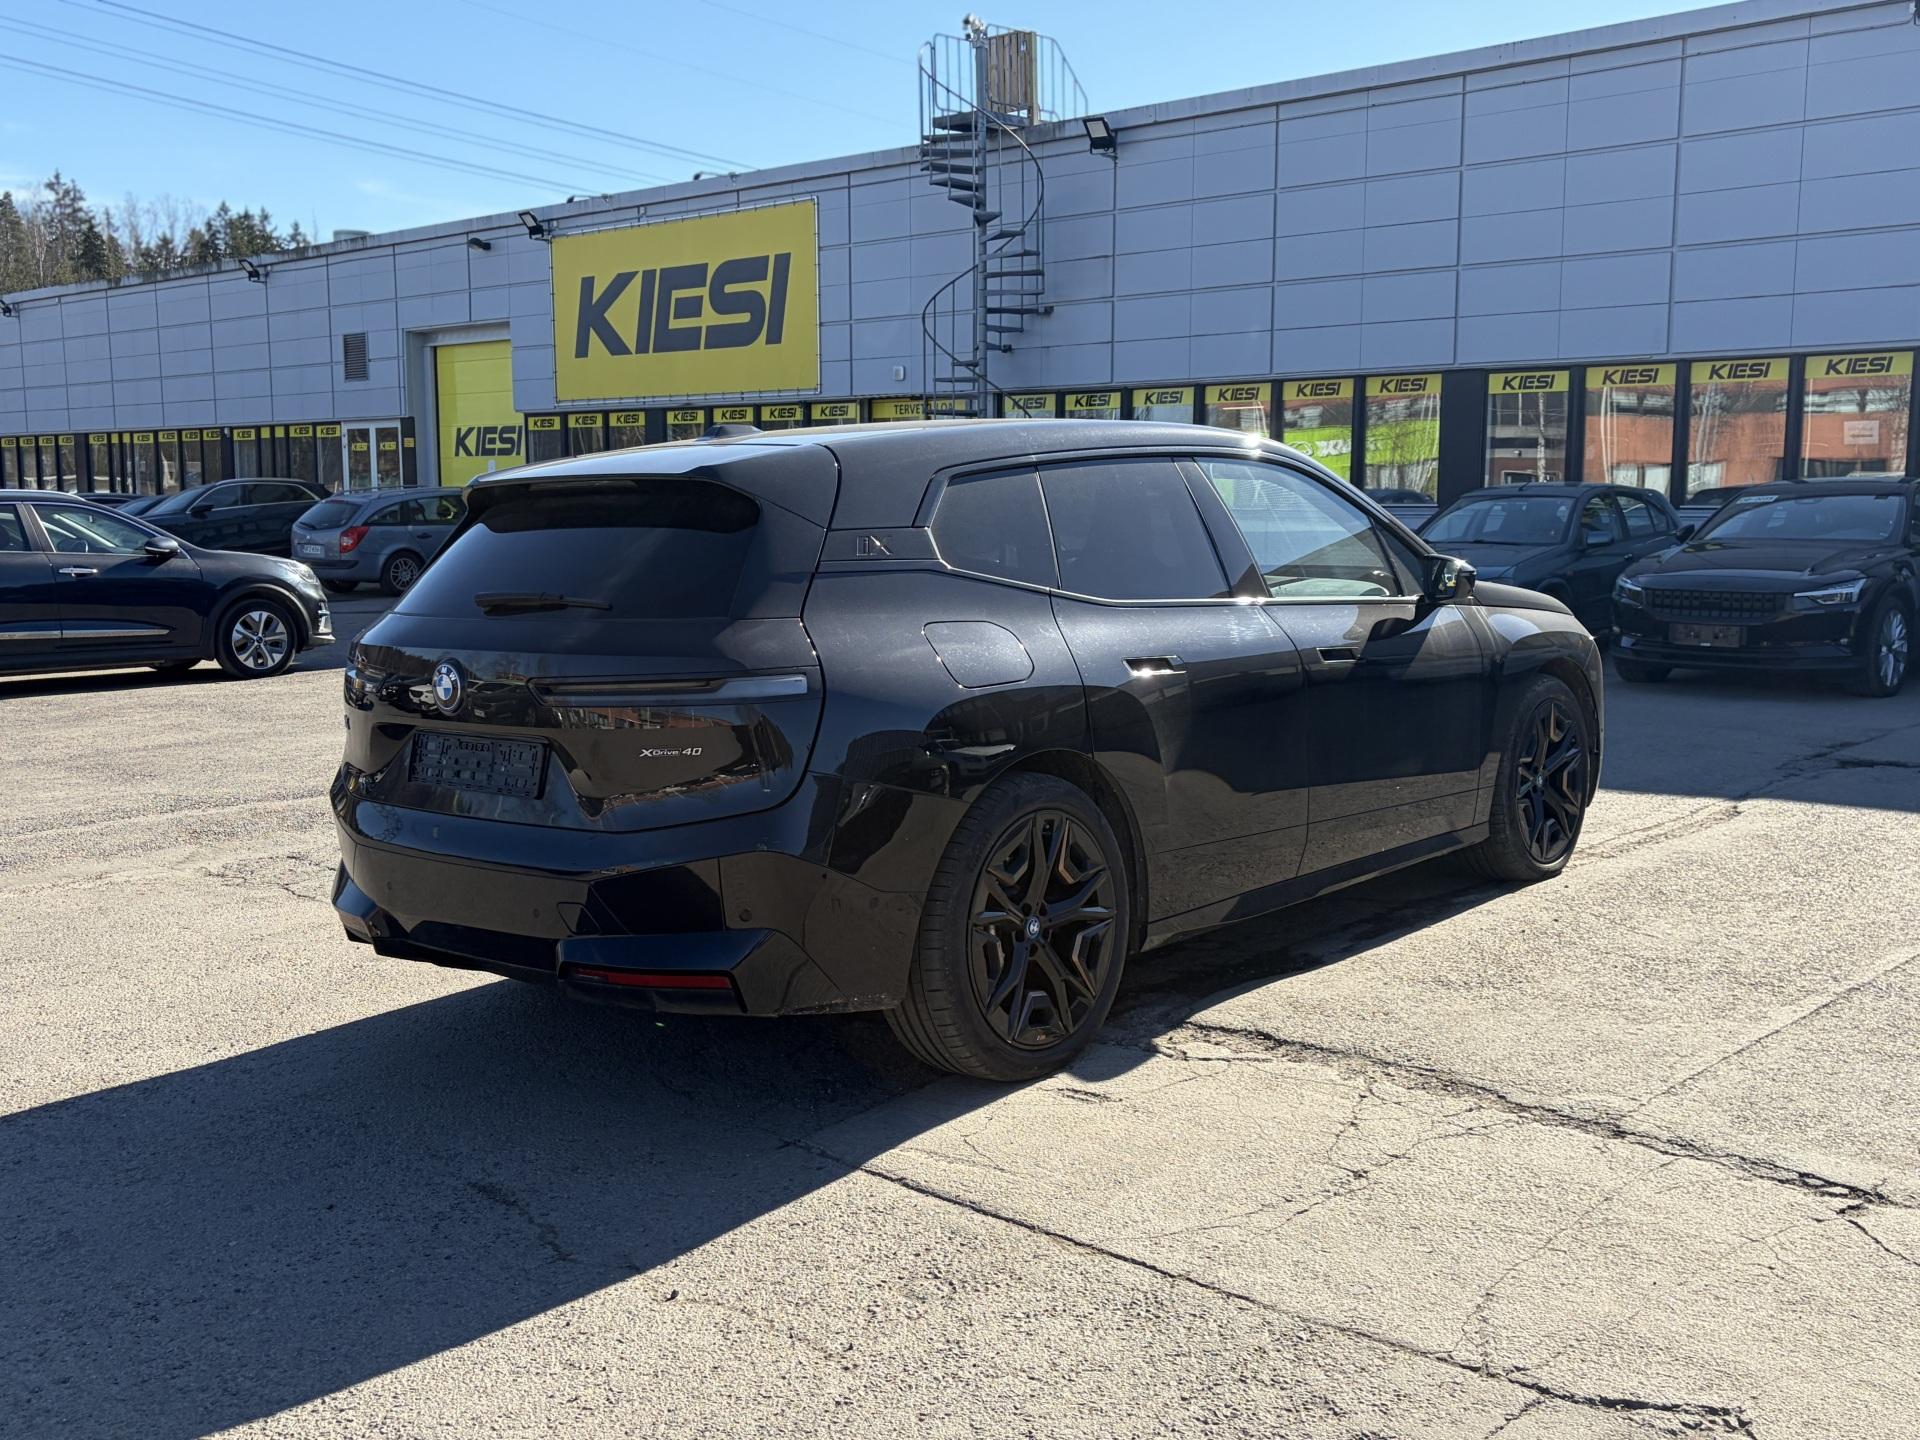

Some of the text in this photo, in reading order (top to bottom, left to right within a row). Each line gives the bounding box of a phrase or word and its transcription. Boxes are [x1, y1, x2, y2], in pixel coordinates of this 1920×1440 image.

[575, 252, 791, 358] KIESI
[1709, 362, 1771, 380] KIESI
[1825, 356, 1893, 375] KIESI
[1502, 374, 1555, 391] KIESI
[1602, 368, 1659, 385] KIESI
[1296, 382, 1341, 397] KIESI
[1380, 377, 1428, 393] KIESI
[1074, 394, 1111, 408] KIESI
[1144, 391, 1183, 405] KIESI
[1218, 387, 1260, 401] KIESI
[1012, 397, 1046, 410] KIESI
[673, 411, 698, 422] KIESI
[721, 409, 747, 420] KIESI
[770, 407, 797, 419] KIESI
[820, 405, 849, 417] KIESI
[533, 418, 555, 429] KIESI
[575, 415, 597, 426] KIESI
[616, 413, 640, 424] KIESI
[454, 425, 523, 457] KIESI
[682, 747, 702, 756] 40
